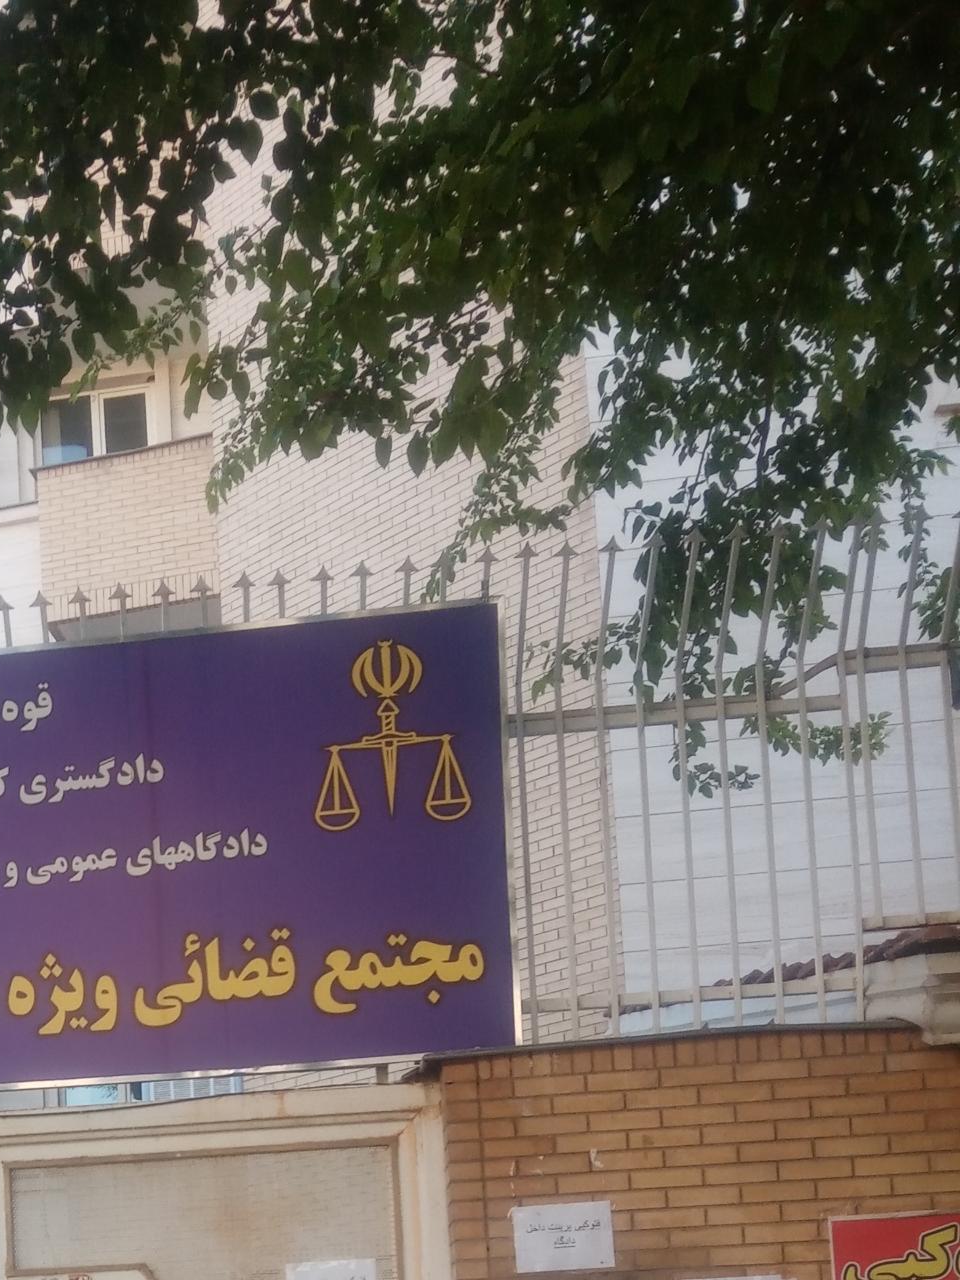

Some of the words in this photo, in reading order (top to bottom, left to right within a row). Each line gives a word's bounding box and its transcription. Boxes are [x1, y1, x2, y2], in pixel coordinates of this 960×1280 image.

[3, 683, 54, 732] قوه
[19, 753, 166, 805] دادگستری
[3, 860, 20, 889] و
[26, 848, 118, 886] عمومی
[126, 828, 269, 878] دادگاههای
[7, 952, 120, 1037] ویژه
[134, 927, 298, 1029] قضائی
[314, 932, 486, 1016] مجتمع
